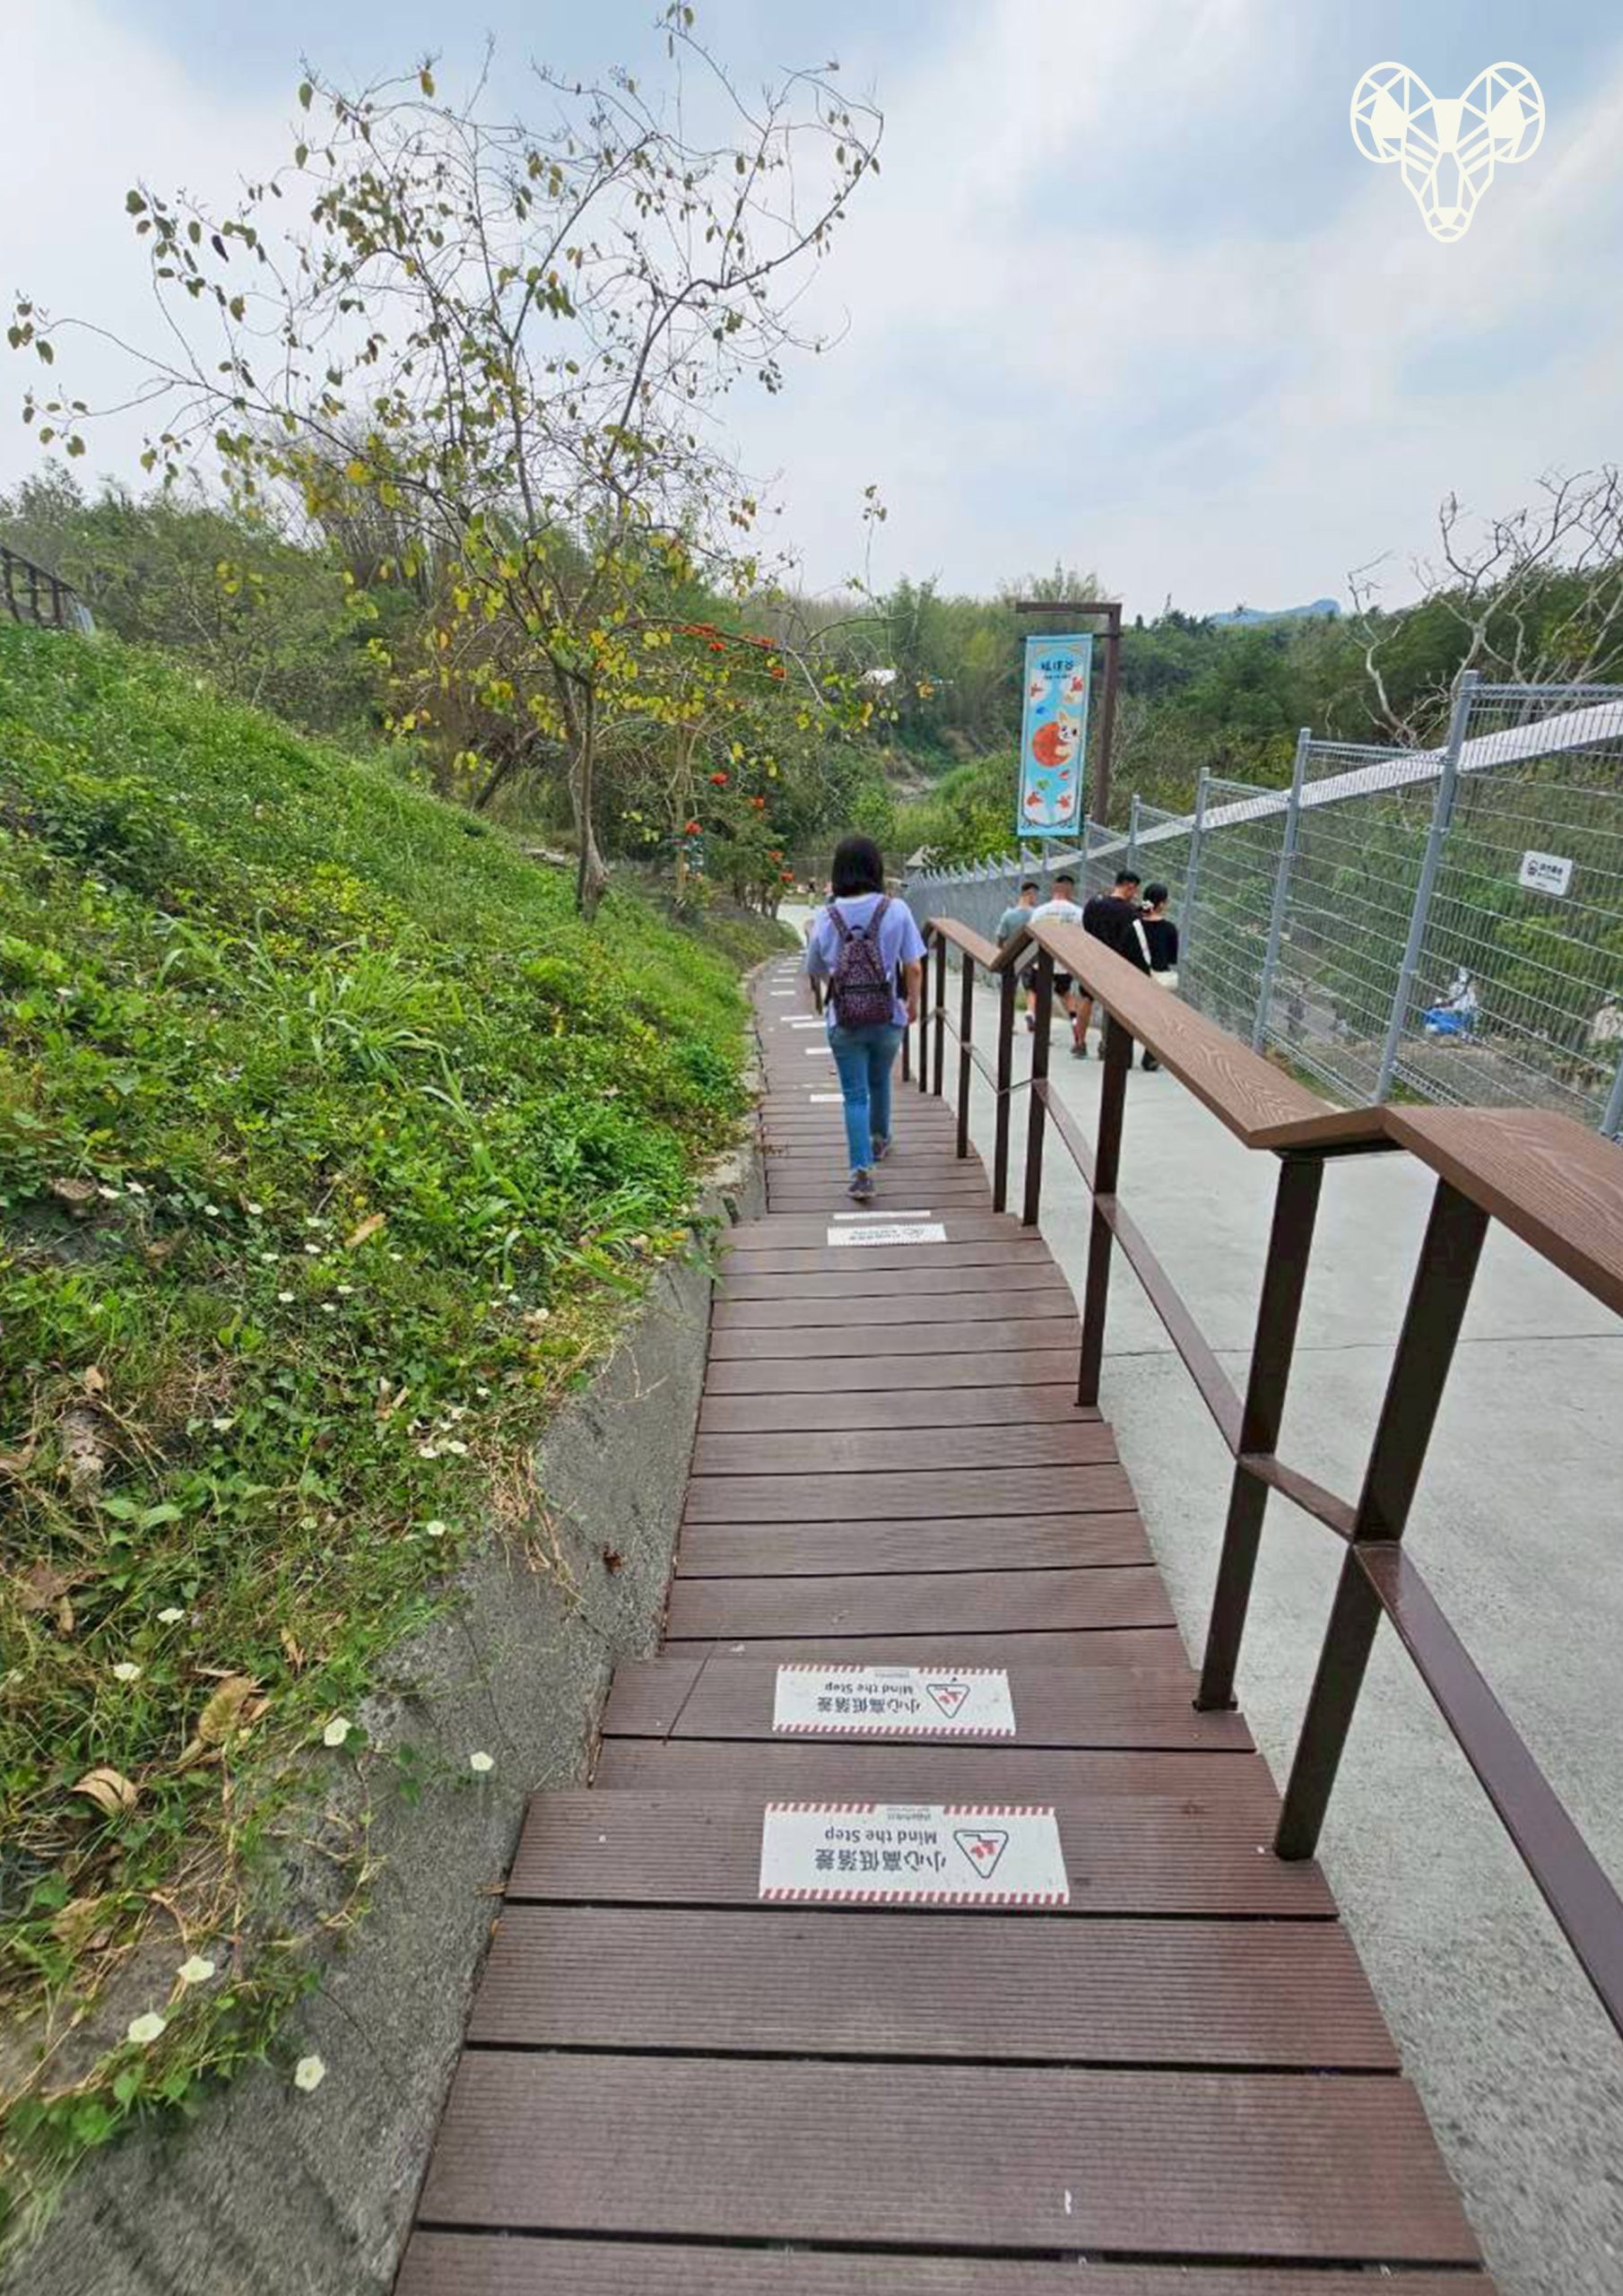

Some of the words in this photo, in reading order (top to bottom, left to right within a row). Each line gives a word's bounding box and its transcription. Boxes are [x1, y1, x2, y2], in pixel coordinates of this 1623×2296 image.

[825, 1682, 853, 1694] Step
[857, 1684, 878, 1694] the
[882, 1684, 914, 1694] Mind
[817, 1697, 921, 1715] 小心高低落差
[825, 1826, 861, 1844] Step
[865, 1830, 892, 1844] the
[898, 1830, 937, 1846] Mind
[814, 1848, 947, 1873] 小心高低落差
